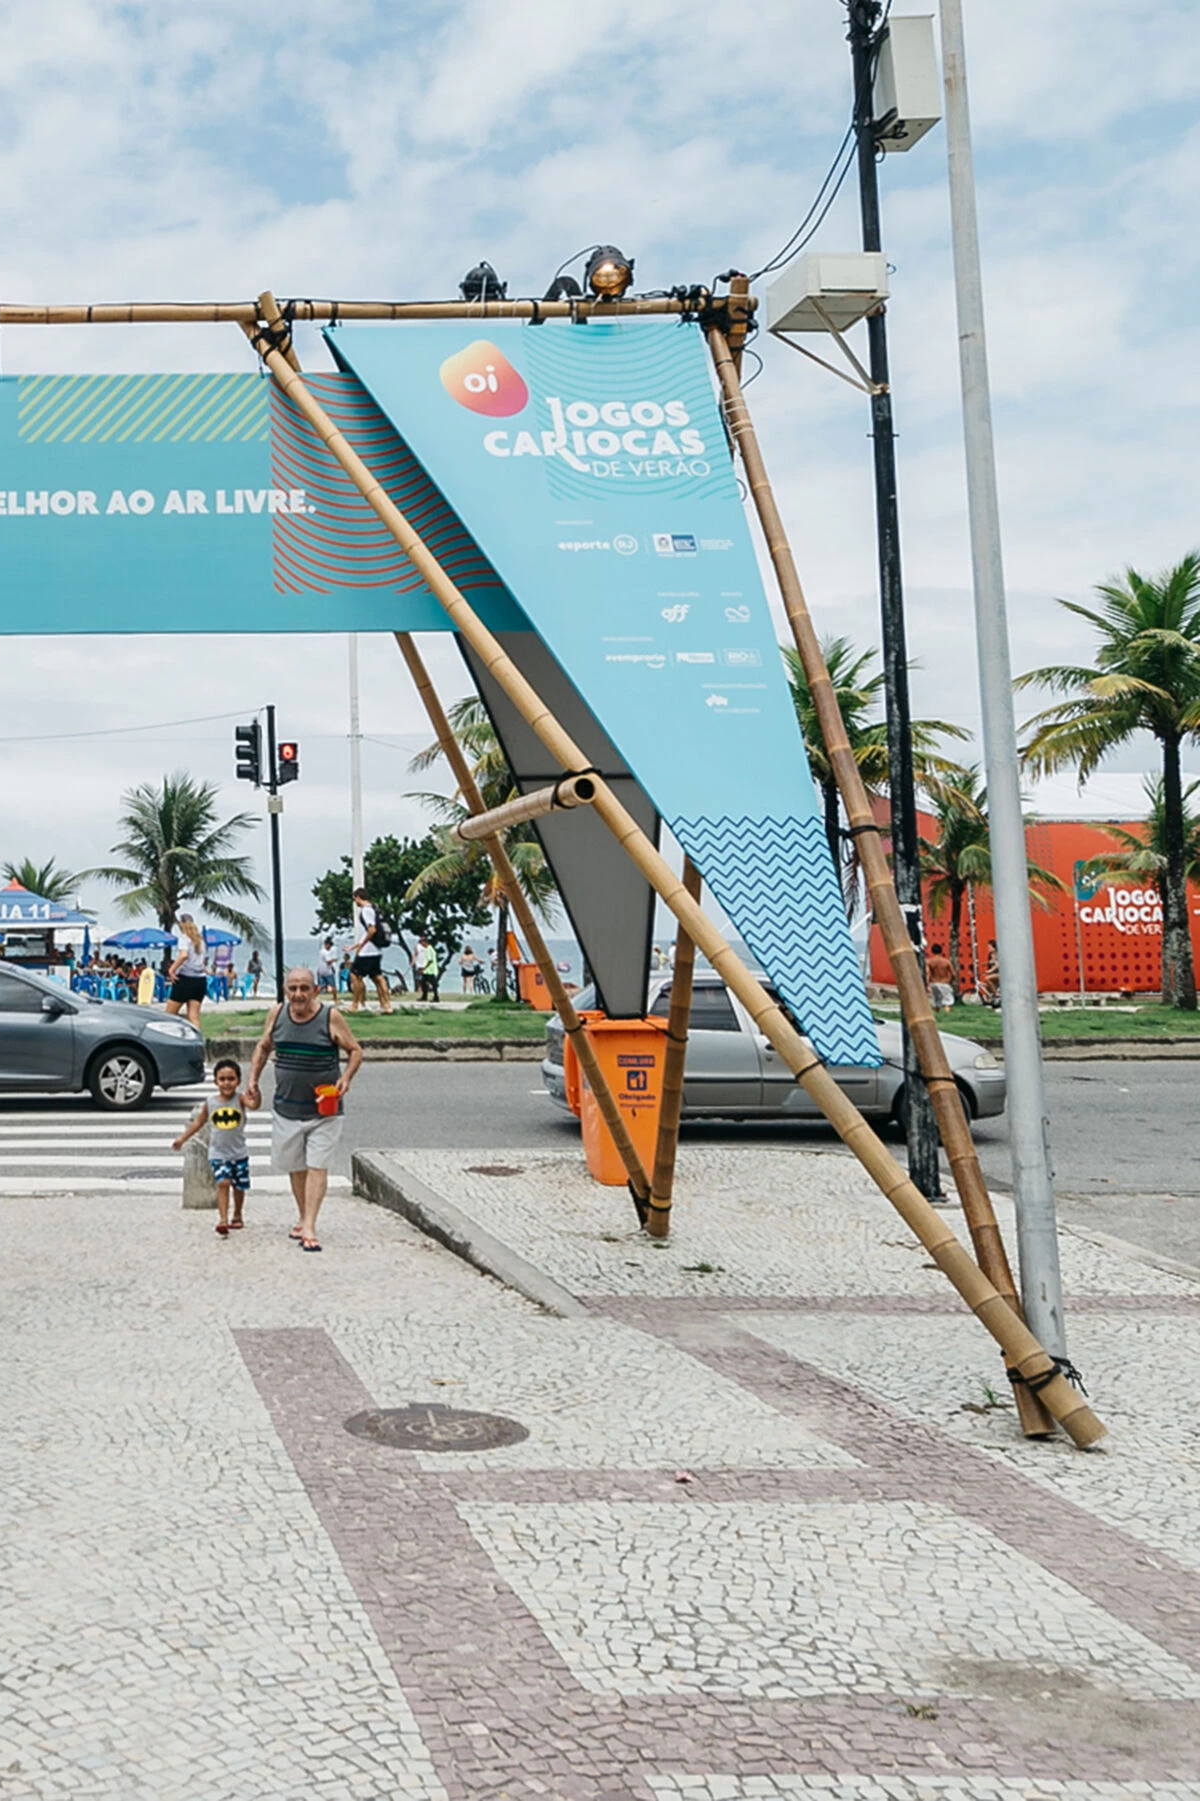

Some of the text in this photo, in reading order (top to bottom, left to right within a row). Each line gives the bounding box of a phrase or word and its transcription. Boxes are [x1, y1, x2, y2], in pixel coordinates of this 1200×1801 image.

[546, 397, 690, 429] JOGOS
[483, 428, 706, 472] CARIOCAS
[592, 456, 711, 477] DE VERÃO
[105, 489, 155, 515] AO
[162, 489, 209, 514] AR
[215, 488, 316, 514] LIVRE.
[28, 903, 50, 919] 11
[1080, 907, 1163, 932] CARIOCA
[1142, 924, 1163, 935] VER
